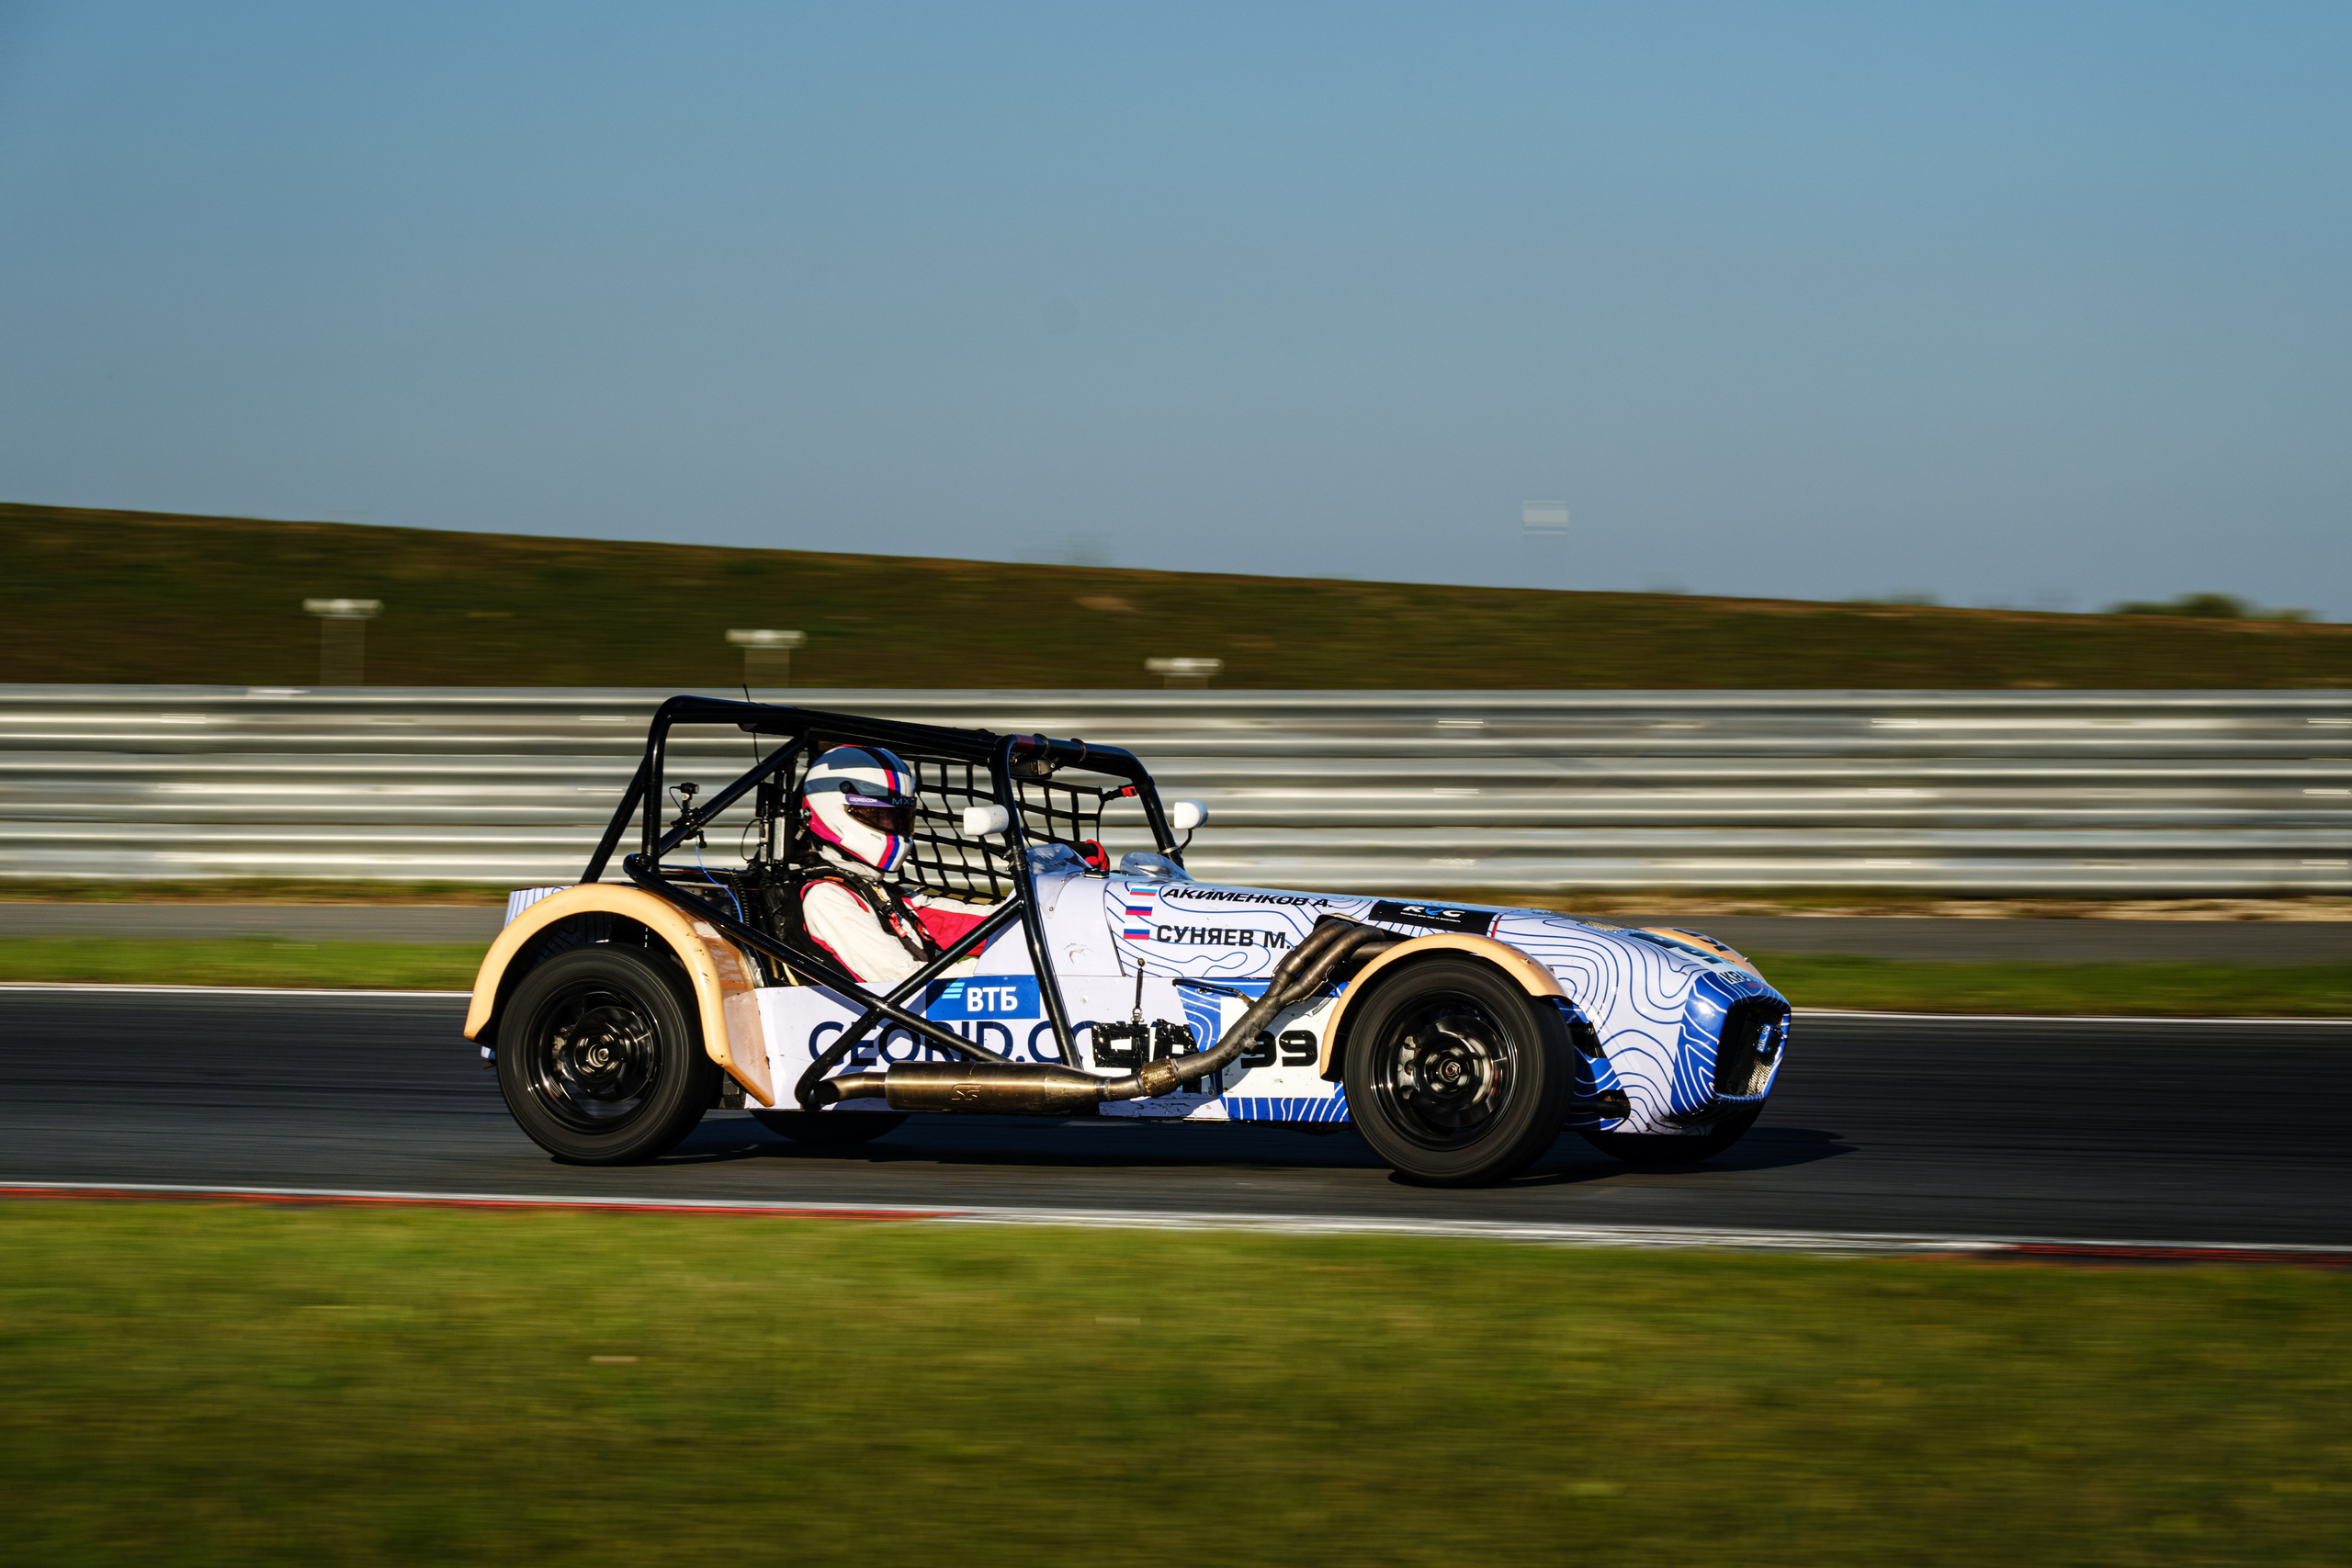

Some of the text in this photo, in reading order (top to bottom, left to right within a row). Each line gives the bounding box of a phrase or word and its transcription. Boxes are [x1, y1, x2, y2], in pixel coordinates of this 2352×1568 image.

[1162, 888, 1333, 908] АКИМЕНКОВ А.
[1156, 924, 1291, 950] СУНЯЕВ М.
[967, 986, 1018, 1012] ВТБ
[1240, 1030, 1317, 1068] 99
